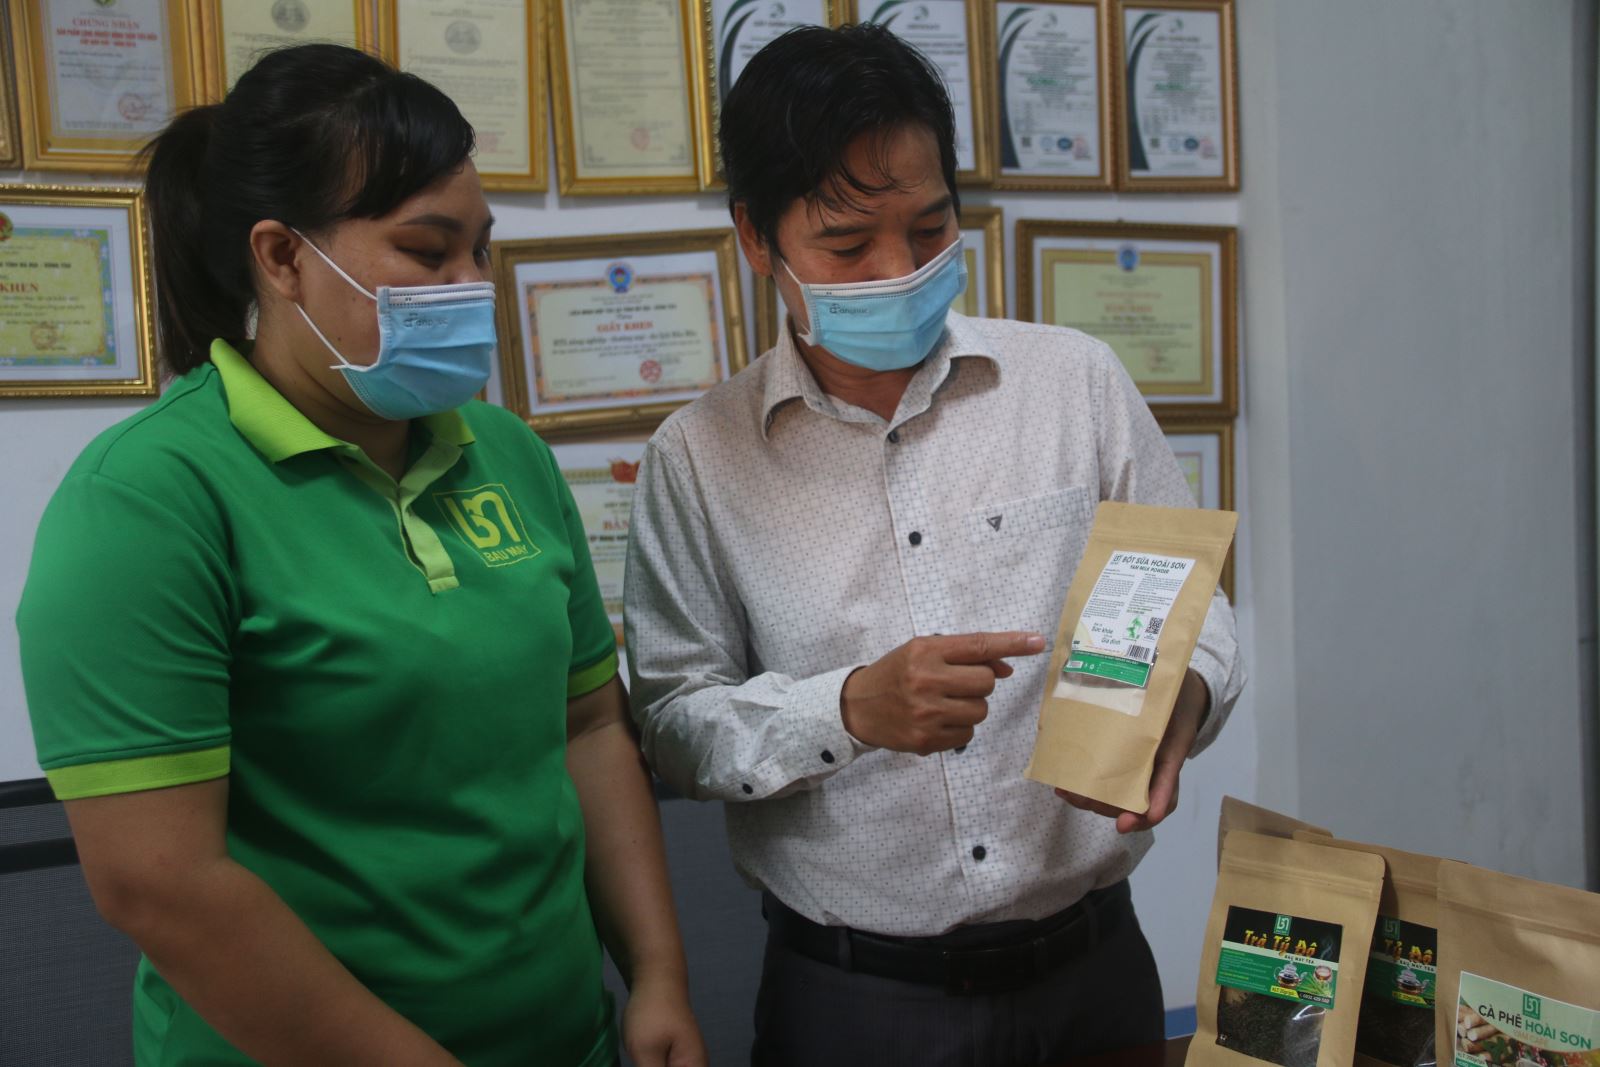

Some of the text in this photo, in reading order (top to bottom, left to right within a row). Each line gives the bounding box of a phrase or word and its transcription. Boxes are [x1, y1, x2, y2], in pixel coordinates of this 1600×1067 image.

[1244, 929, 1268, 948] Trà
[1478, 1004, 1592, 1050] CÀ PHÊ HOÀI SƠN
